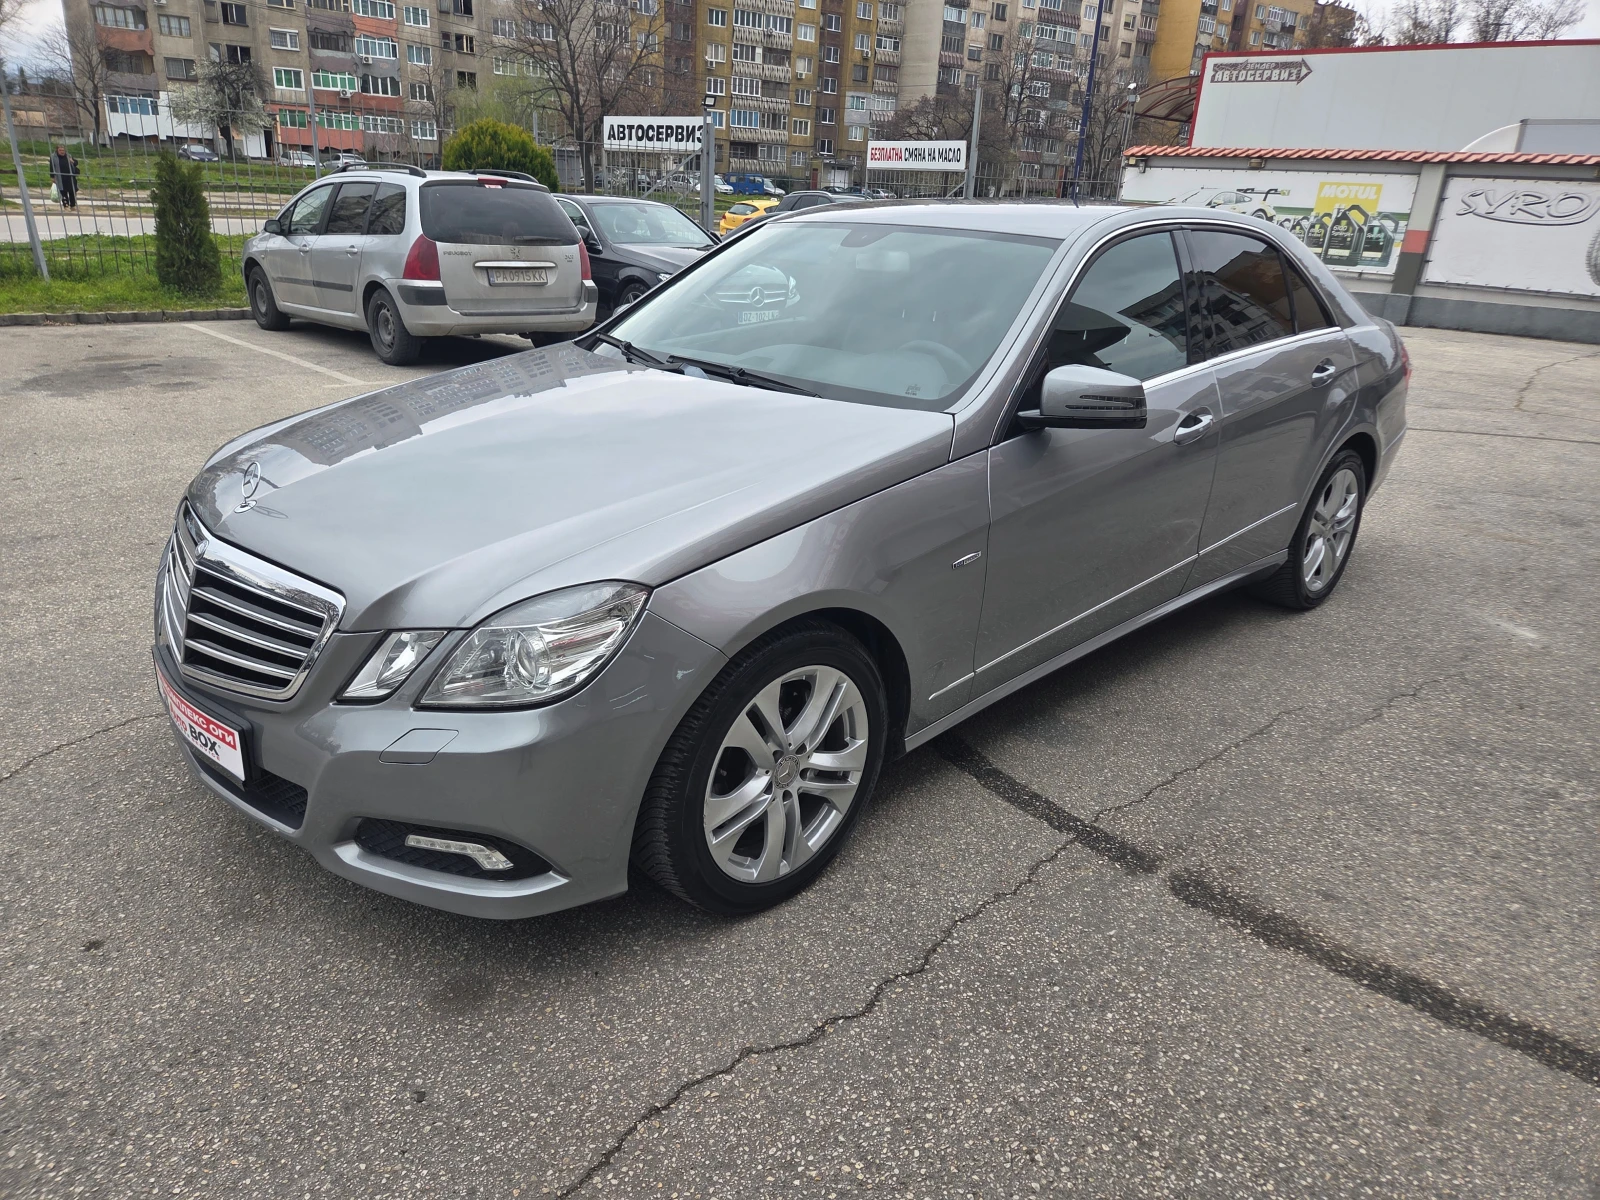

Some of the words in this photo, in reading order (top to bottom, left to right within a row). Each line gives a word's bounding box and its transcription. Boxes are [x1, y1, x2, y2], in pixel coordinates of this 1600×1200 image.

[1214, 68, 1298, 82] АВТОСЕРВИЗ
[870, 147, 903, 162] БЕЗПЛАТНА
[904, 147, 926, 162] СМЯНА
[927, 147, 936, 162] НА
[937, 147, 962, 163] МАСЛО
[1320, 184, 1378, 200] MOTUL
[161, 677, 208, 728] МПЛЕКС
[209, 724, 235, 746] ОГИ
[188, 723, 220, 757] BOX
